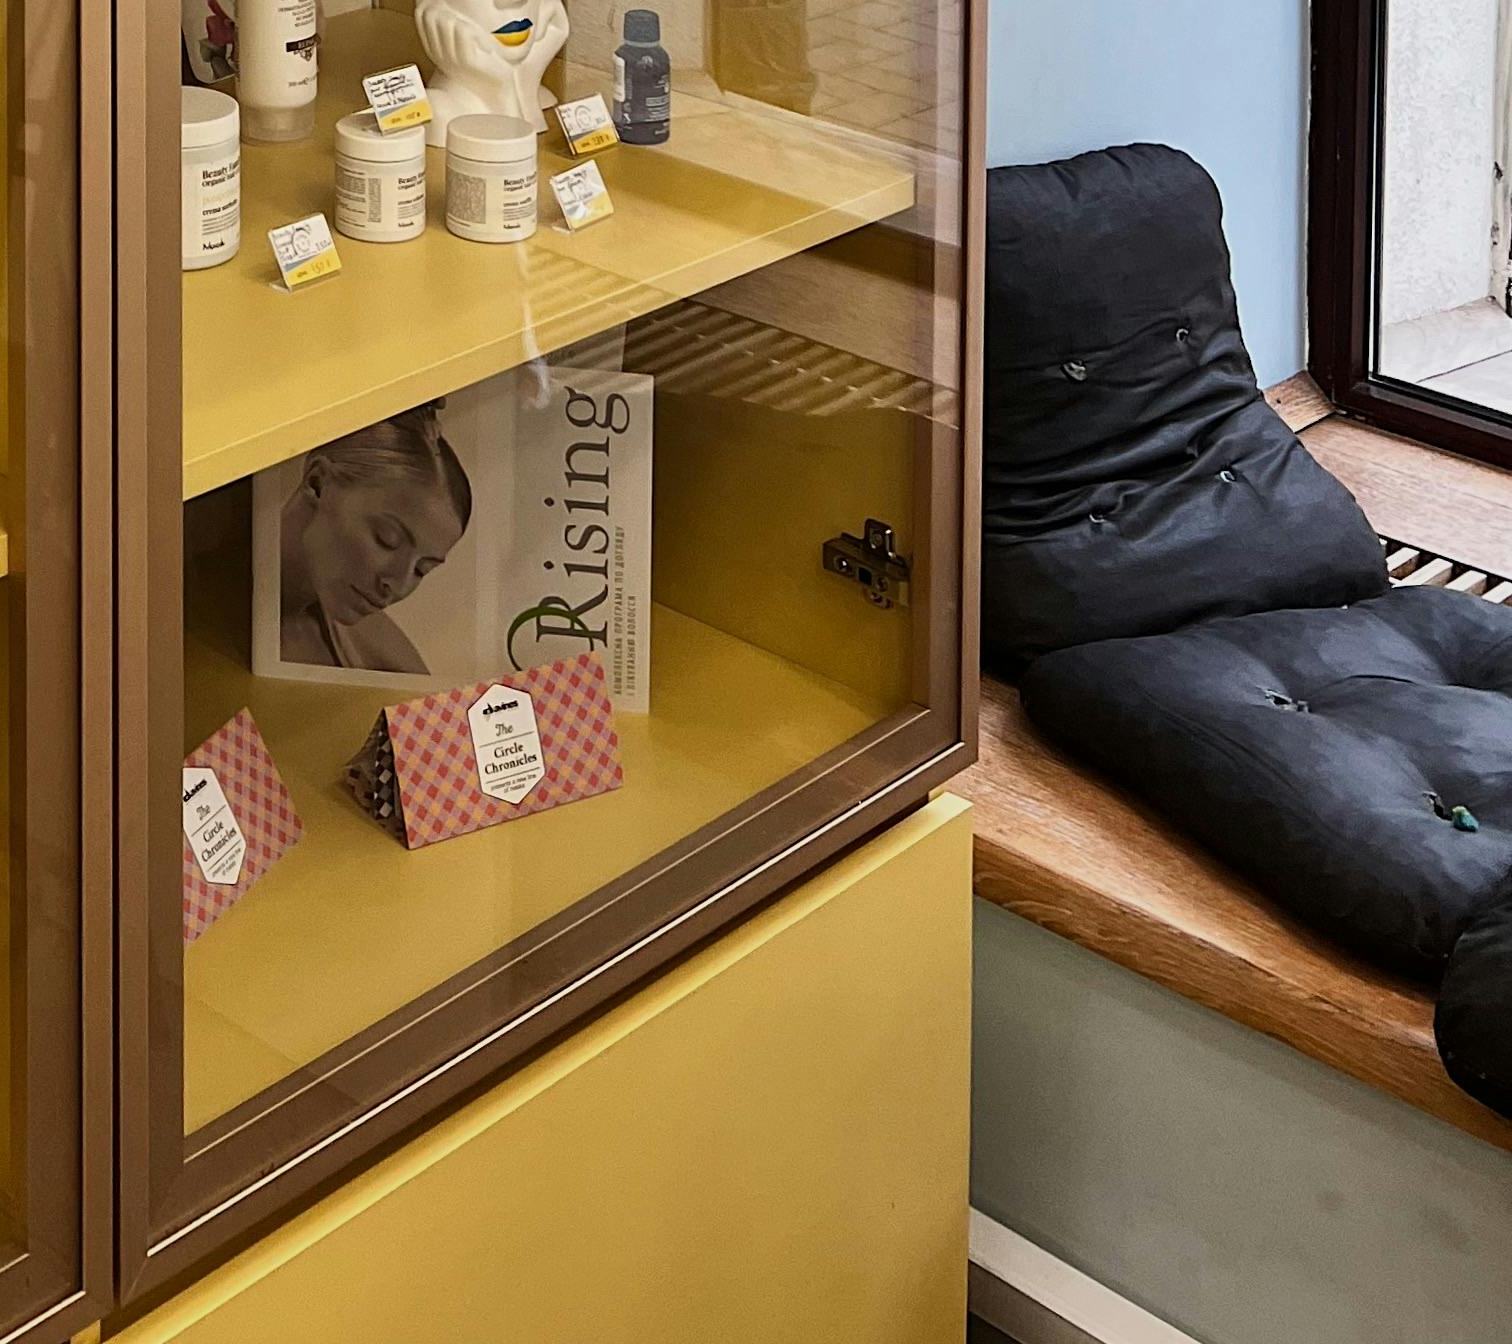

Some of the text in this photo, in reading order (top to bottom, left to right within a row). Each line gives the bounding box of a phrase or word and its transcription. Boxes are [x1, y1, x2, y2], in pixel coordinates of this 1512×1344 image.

[495, 723, 513, 737] The
[493, 742, 524, 759] Circle
[484, 753, 537, 775] Chronicles
[202, 819, 225, 843] Circle
